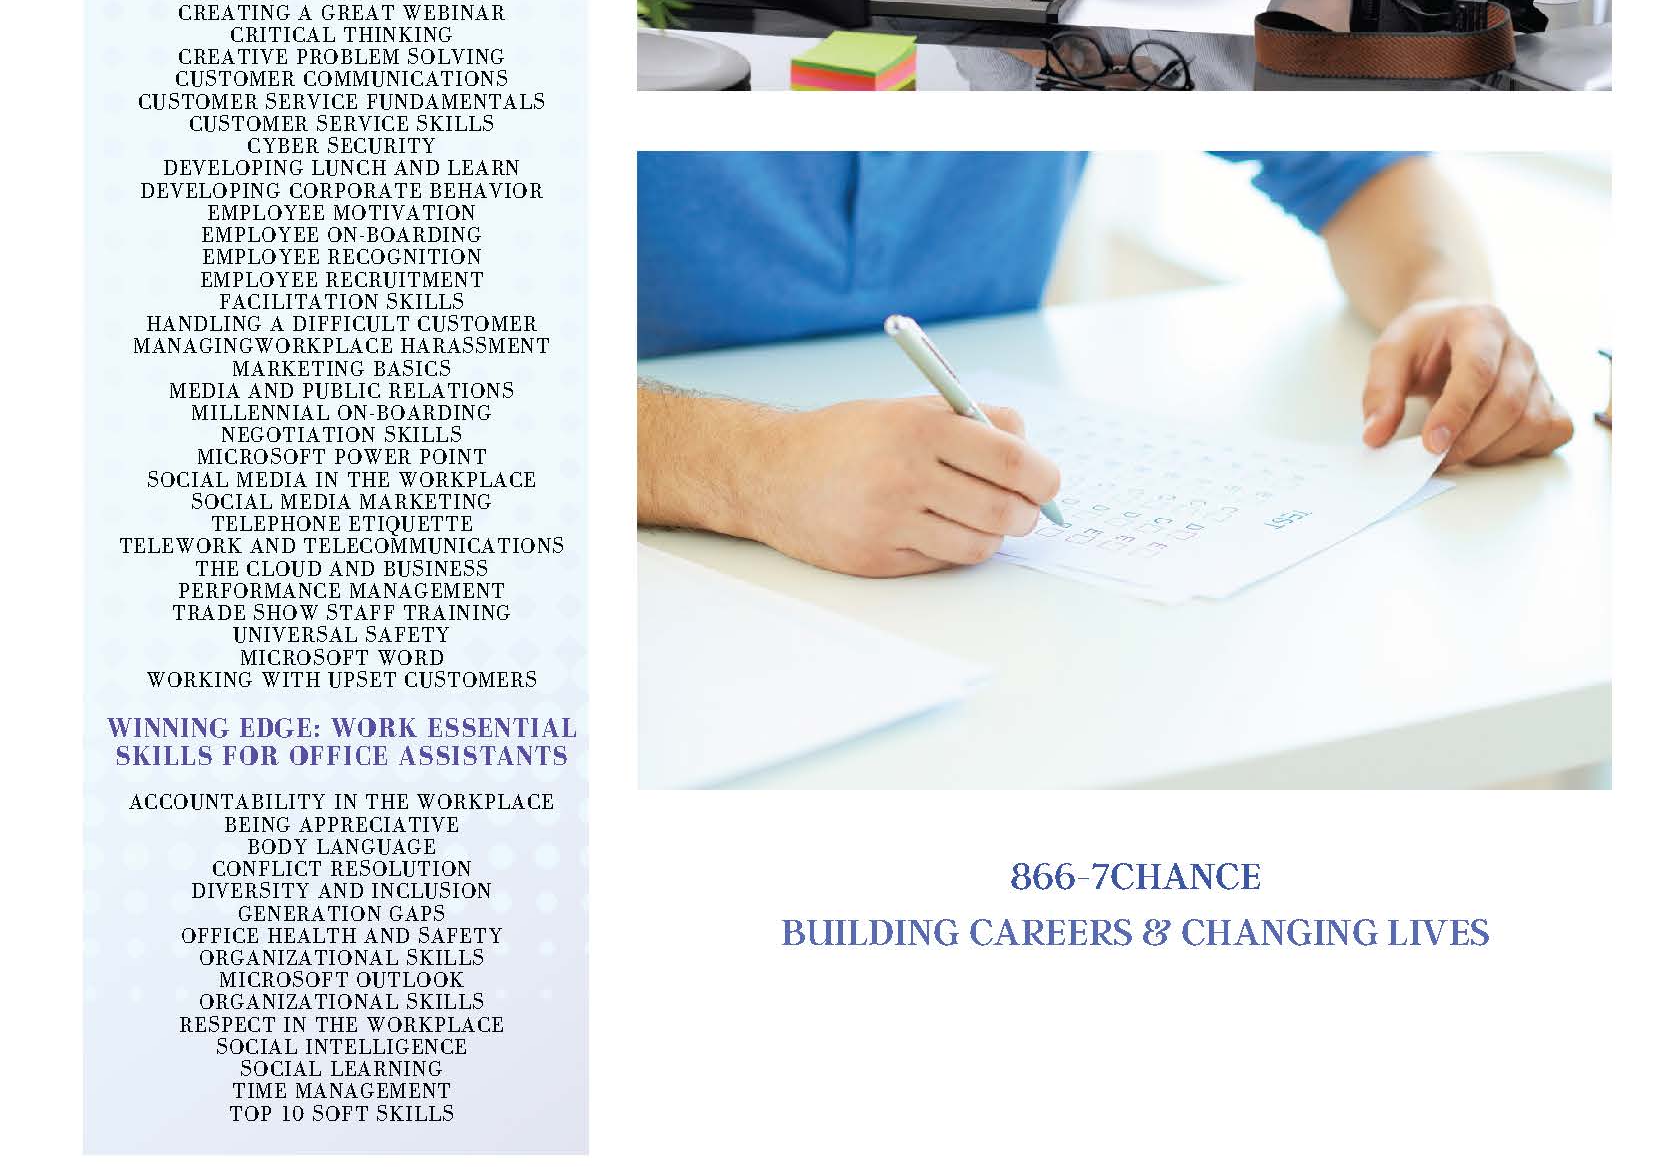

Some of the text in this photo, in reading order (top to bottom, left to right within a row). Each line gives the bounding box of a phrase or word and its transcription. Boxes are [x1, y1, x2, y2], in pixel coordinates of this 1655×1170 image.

[230, 26, 453, 43] CRITICAL THINKING
[189, 114, 494, 133] CUSTOMER SERVICE SKILLS
[140, 182, 544, 199] DEVELOPING CORPORATE BEHAVIOR
[202, 248, 482, 265] EMPLOYEE RECOGNITION
[133, 336, 550, 354] MANAGINGWORKPLACE HARASSMENT
[232, 359, 451, 377] MARKETING BASICS
[191, 404, 492, 421] MILLENNIAL ON-BOARDING
[191, 492, 492, 510] SOCIAL MEDIA MARKETING
[195, 559, 488, 578] THE CLOUD AND BUSINESS
[232, 625, 450, 644] UNIVERSAL SAFETY
[106, 717, 577, 739] WINNING EDGE: WORK ESSENTIAL
[116, 745, 568, 766] SKILLS FOR OFFICE ASSISTANTS
[224, 816, 459, 833] BEING APPRECIATIVE
[247, 838, 436, 856] BODY LANGUAGE
[1010, 862, 1261, 891] 866-7CHANCE
[238, 904, 445, 922] GENERATION GAPS
[781, 918, 1490, 947] BUILDING CAREERS & CHANGING LIVES
[199, 948, 484, 966] ORGANIZATIONAL SKILLS
[199, 992, 484, 1010] ORGANIZATIONAL SKILLS
[216, 1037, 467, 1055] SOCIAL INTELLIGENCE
